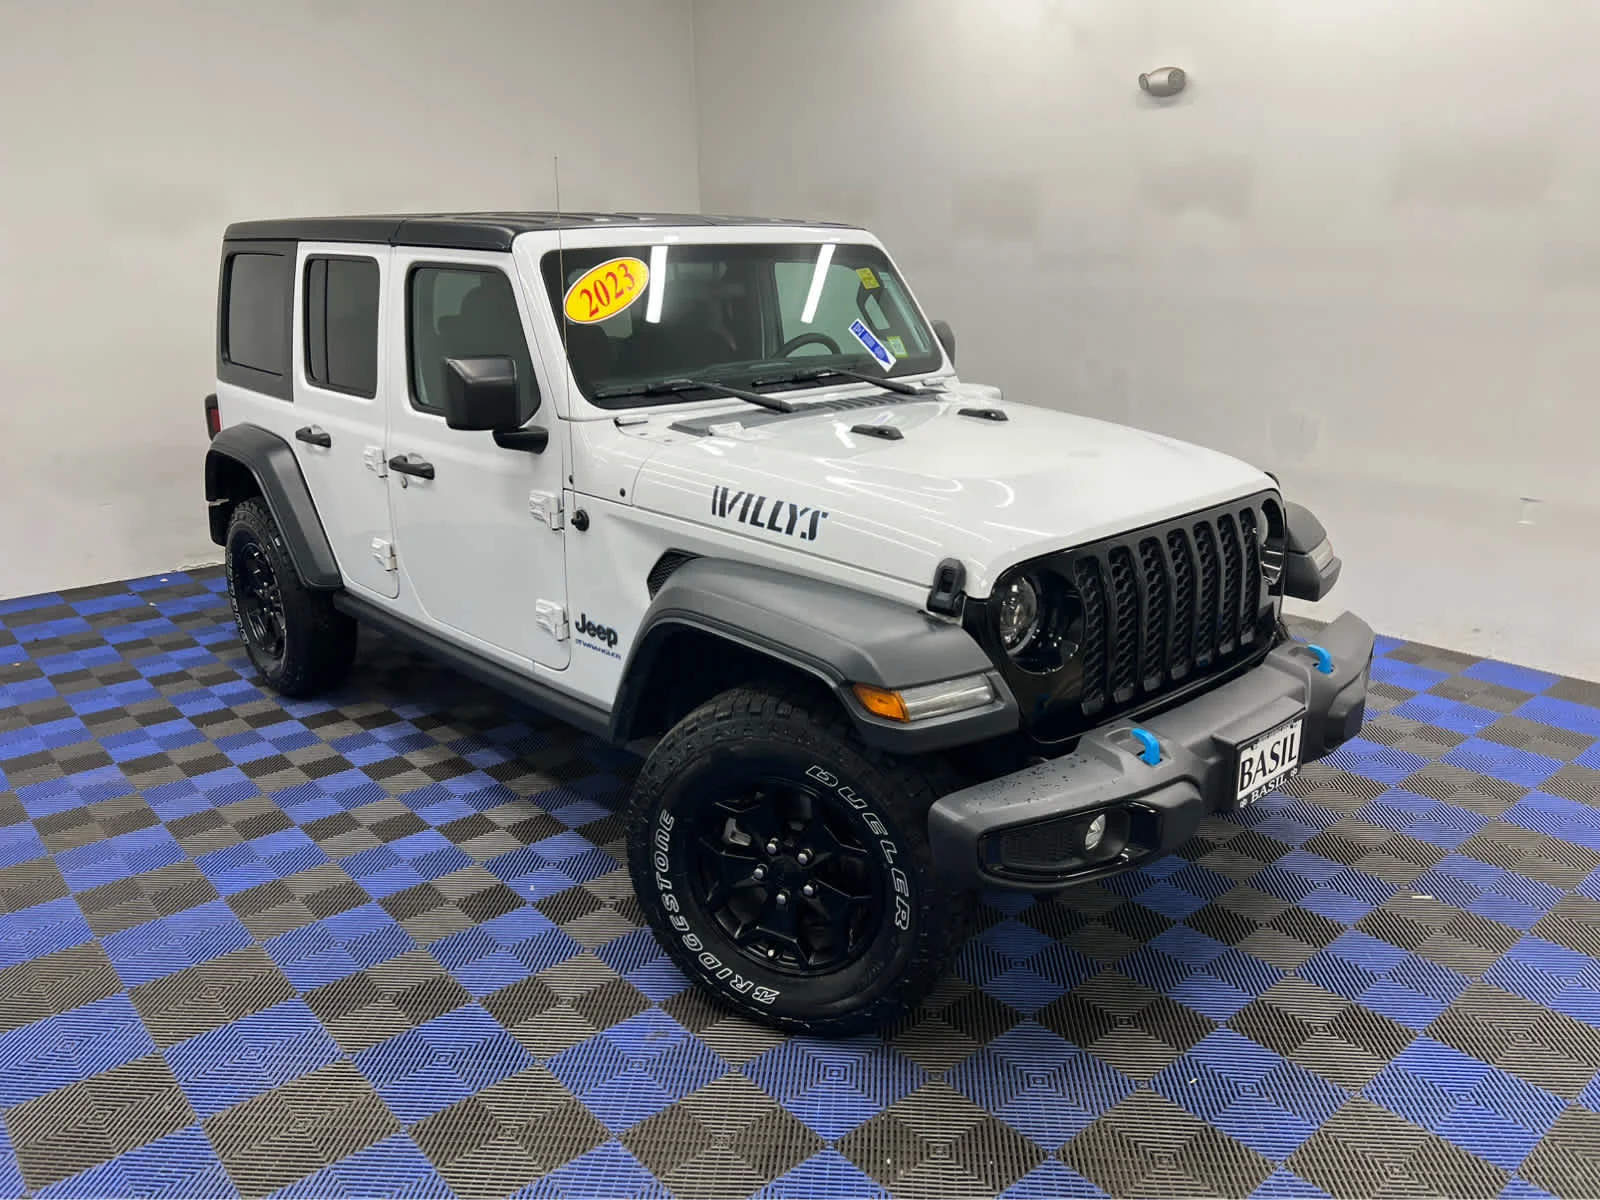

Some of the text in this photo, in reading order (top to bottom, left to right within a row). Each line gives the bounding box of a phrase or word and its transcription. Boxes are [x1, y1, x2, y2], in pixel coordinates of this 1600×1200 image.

[580, 264, 635, 317] 2023
[711, 485, 829, 541] WILLYS
[575, 613, 618, 648] Jeep
[1239, 733, 1297, 792] BASIL
[1250, 774, 1287, 803] BASIL
[805, 765, 910, 931] DUELER
[653, 809, 781, 1004] BRIDGESTONE
